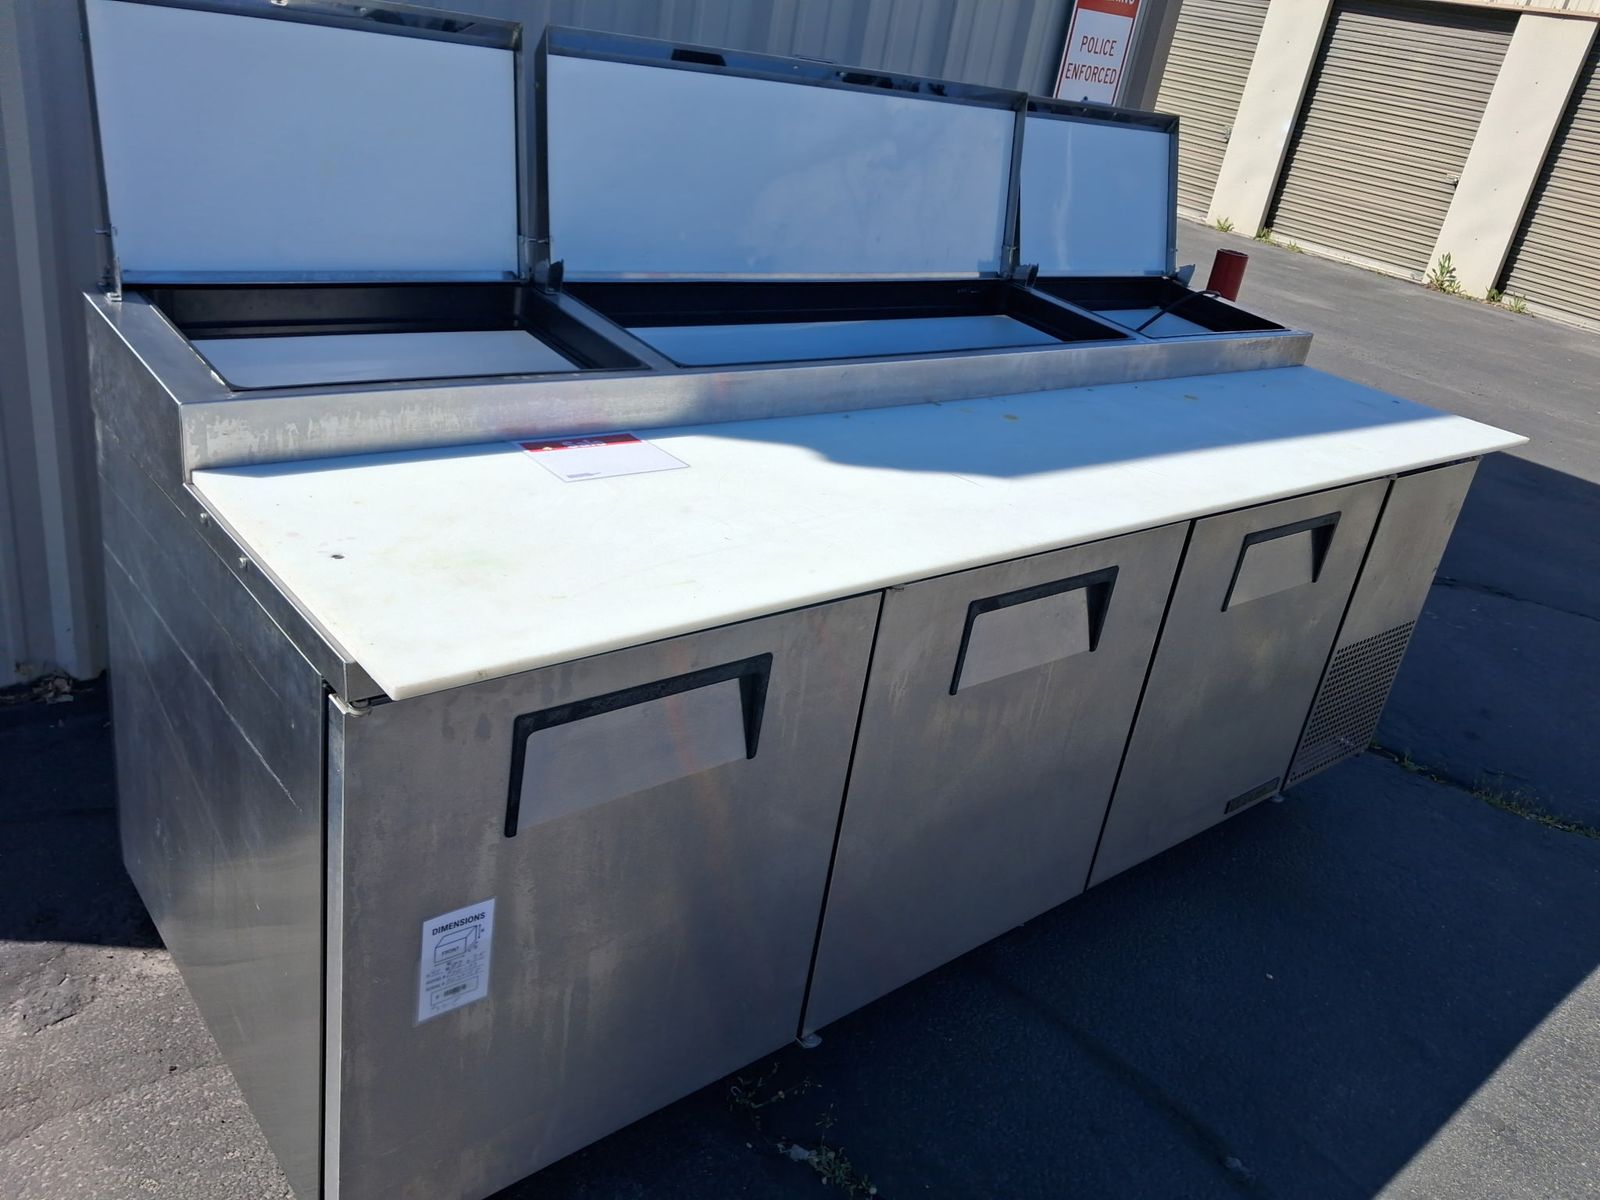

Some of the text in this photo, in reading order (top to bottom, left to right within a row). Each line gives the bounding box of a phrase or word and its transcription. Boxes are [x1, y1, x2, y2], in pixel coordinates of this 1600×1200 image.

[1080, 36, 1117, 56] POLICE
[1065, 63, 1117, 85] ENFORCED
[432, 912, 486, 936] DIMENSIONS
